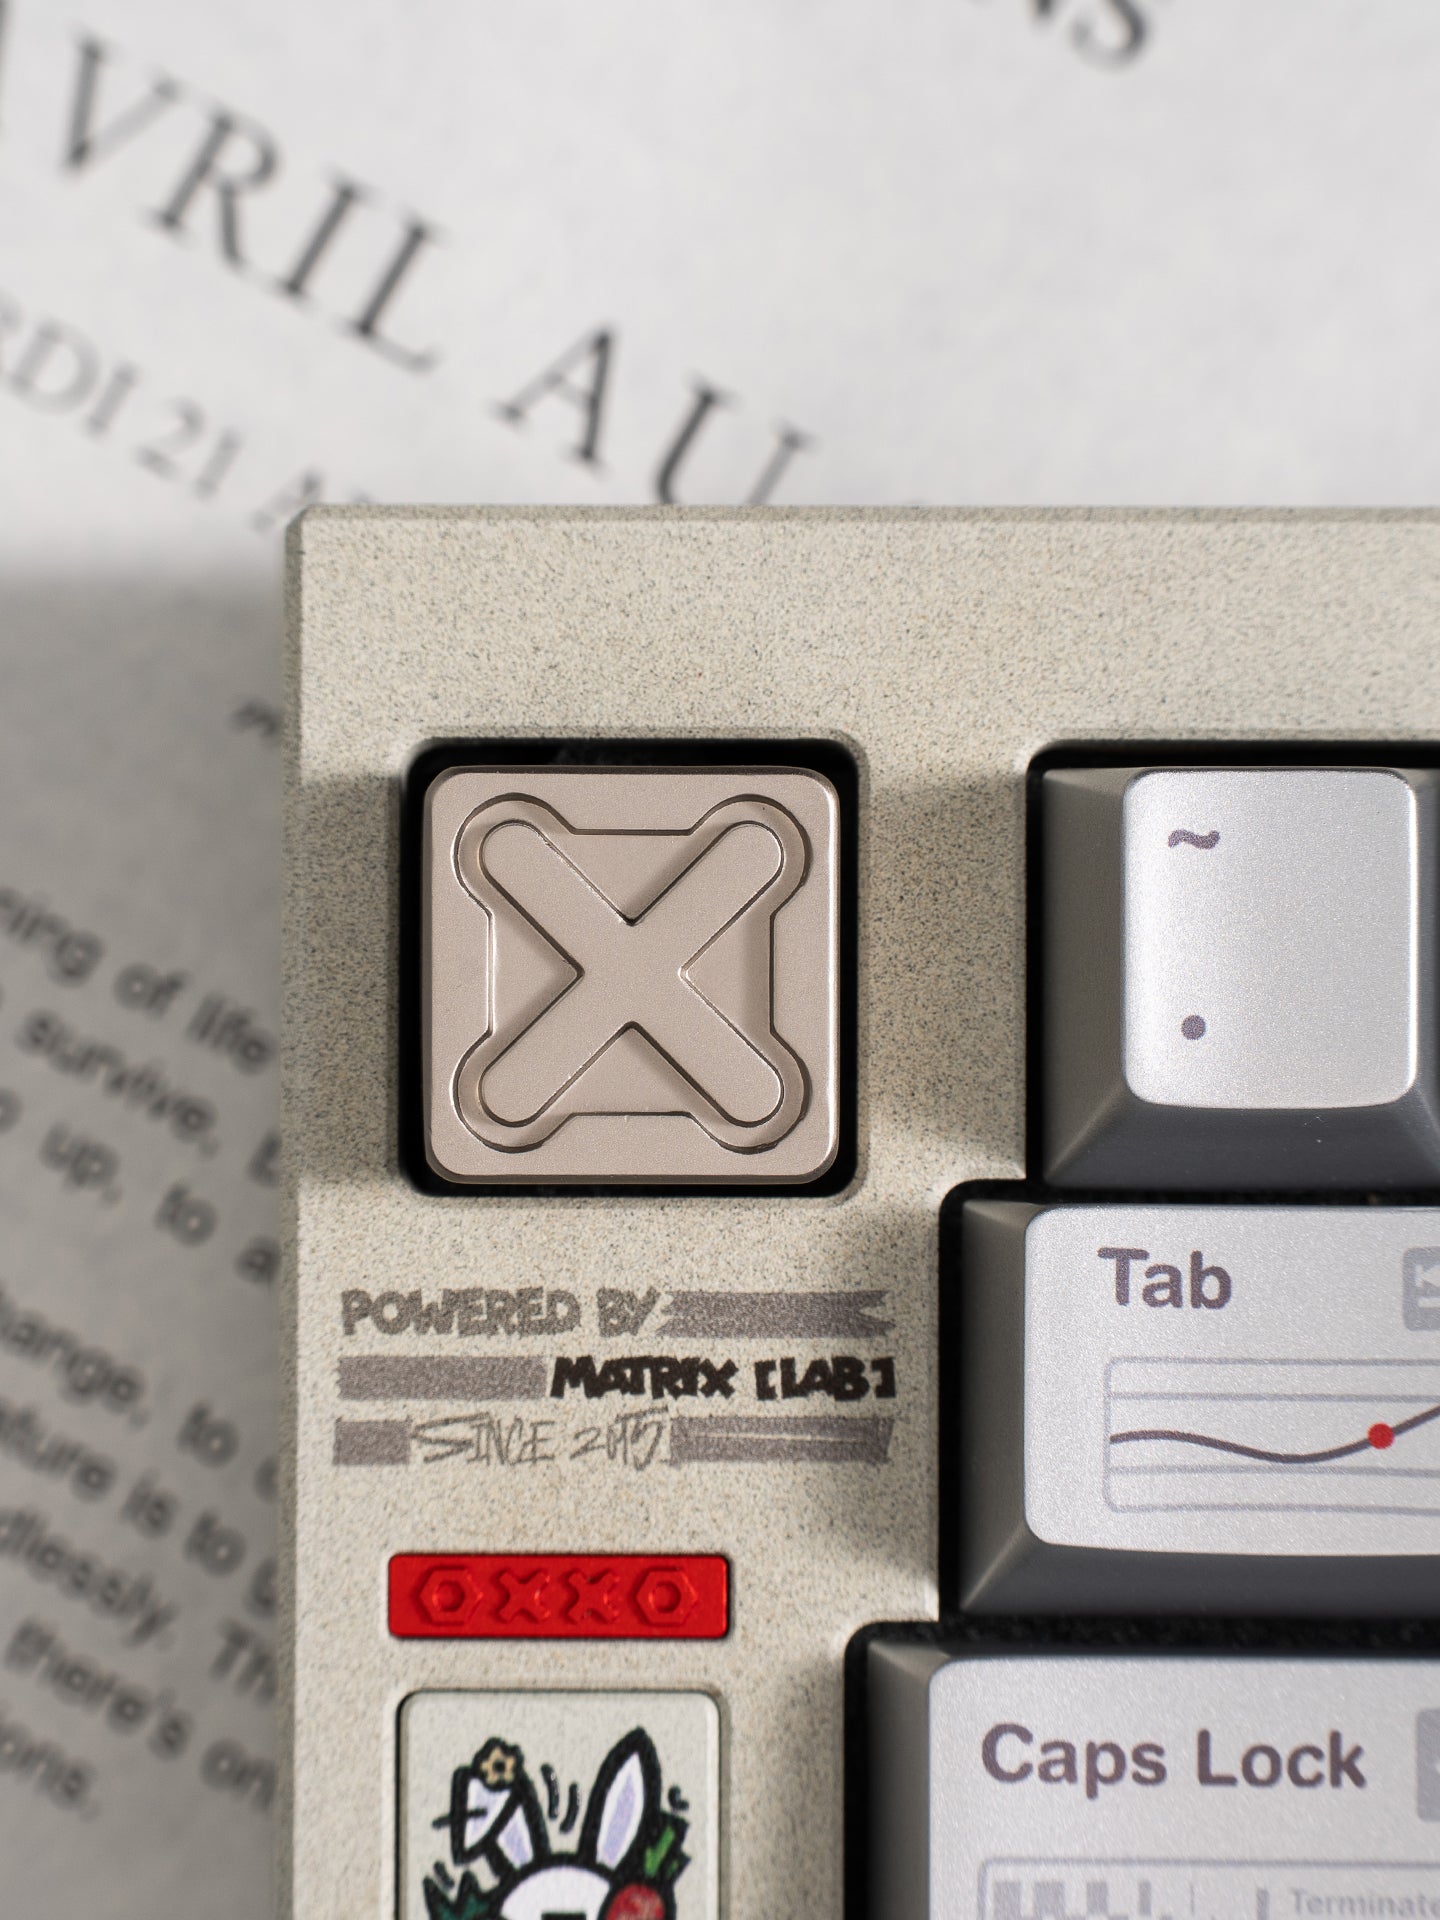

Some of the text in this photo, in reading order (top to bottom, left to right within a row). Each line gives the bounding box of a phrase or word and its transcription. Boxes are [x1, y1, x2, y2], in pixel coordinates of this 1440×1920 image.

[0, 0, 445, 375] VRIL
[0, 295, 140, 440] DI
[1098, 1247, 1232, 1309] Tab
[340, 1287, 661, 1337] POWERED BY
[550, 1356, 896, 1400] MATRIX [LAB]
[410, 1411, 556, 1467] SINCE
[981, 1722, 1367, 1800] Caps Lock
